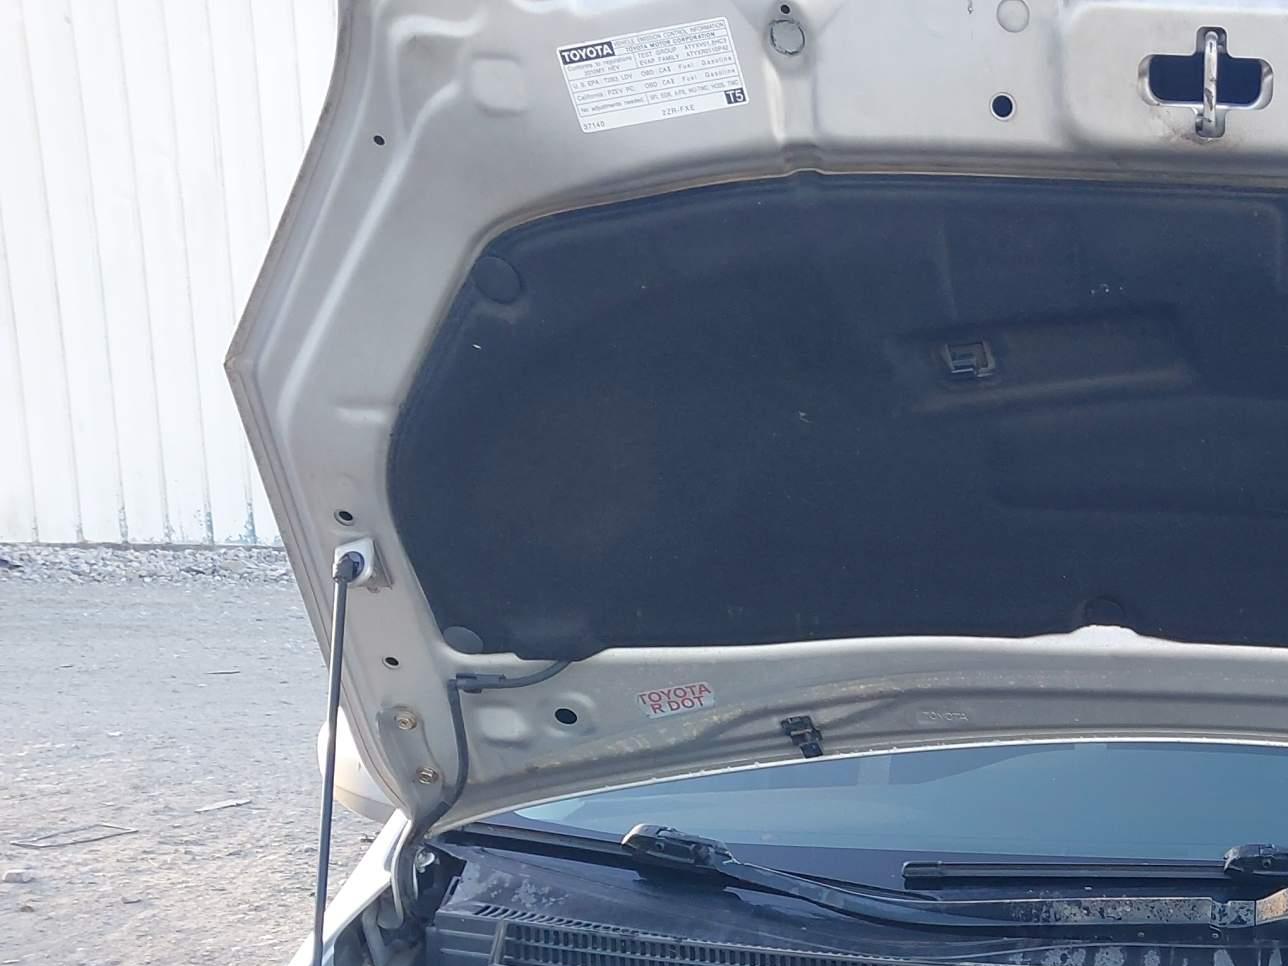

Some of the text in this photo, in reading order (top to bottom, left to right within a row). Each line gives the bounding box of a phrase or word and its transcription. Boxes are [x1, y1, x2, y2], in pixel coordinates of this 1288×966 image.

[562, 43, 613, 63] TOYOTA
[726, 90, 744, 104] T5
[639, 684, 712, 705] TOYOTA
[650, 695, 704, 714] R DOT
